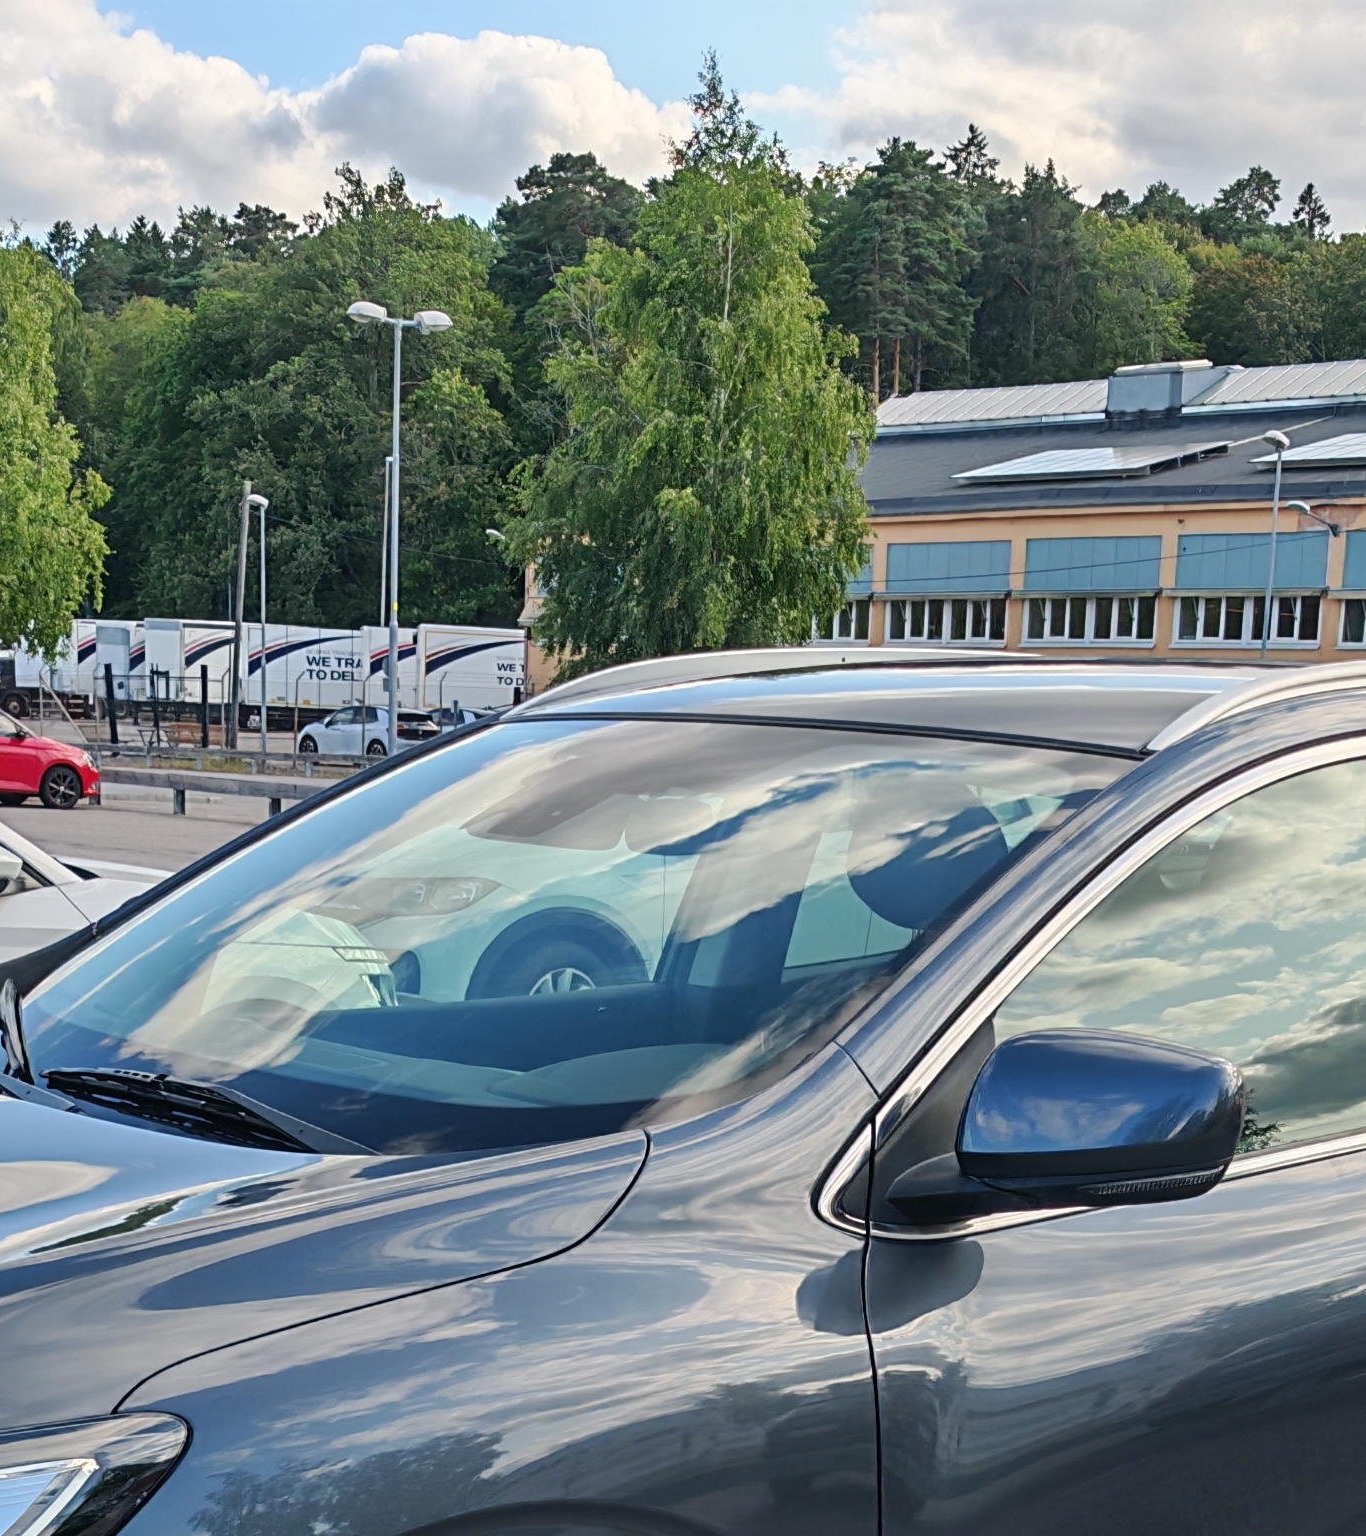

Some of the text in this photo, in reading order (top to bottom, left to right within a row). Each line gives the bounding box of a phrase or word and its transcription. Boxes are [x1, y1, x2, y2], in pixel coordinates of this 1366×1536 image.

[306, 655, 332, 667] WE
[496, 662, 517, 672] WE
[305, 668, 327, 681] TO
[496, 676, 514, 686] TO
